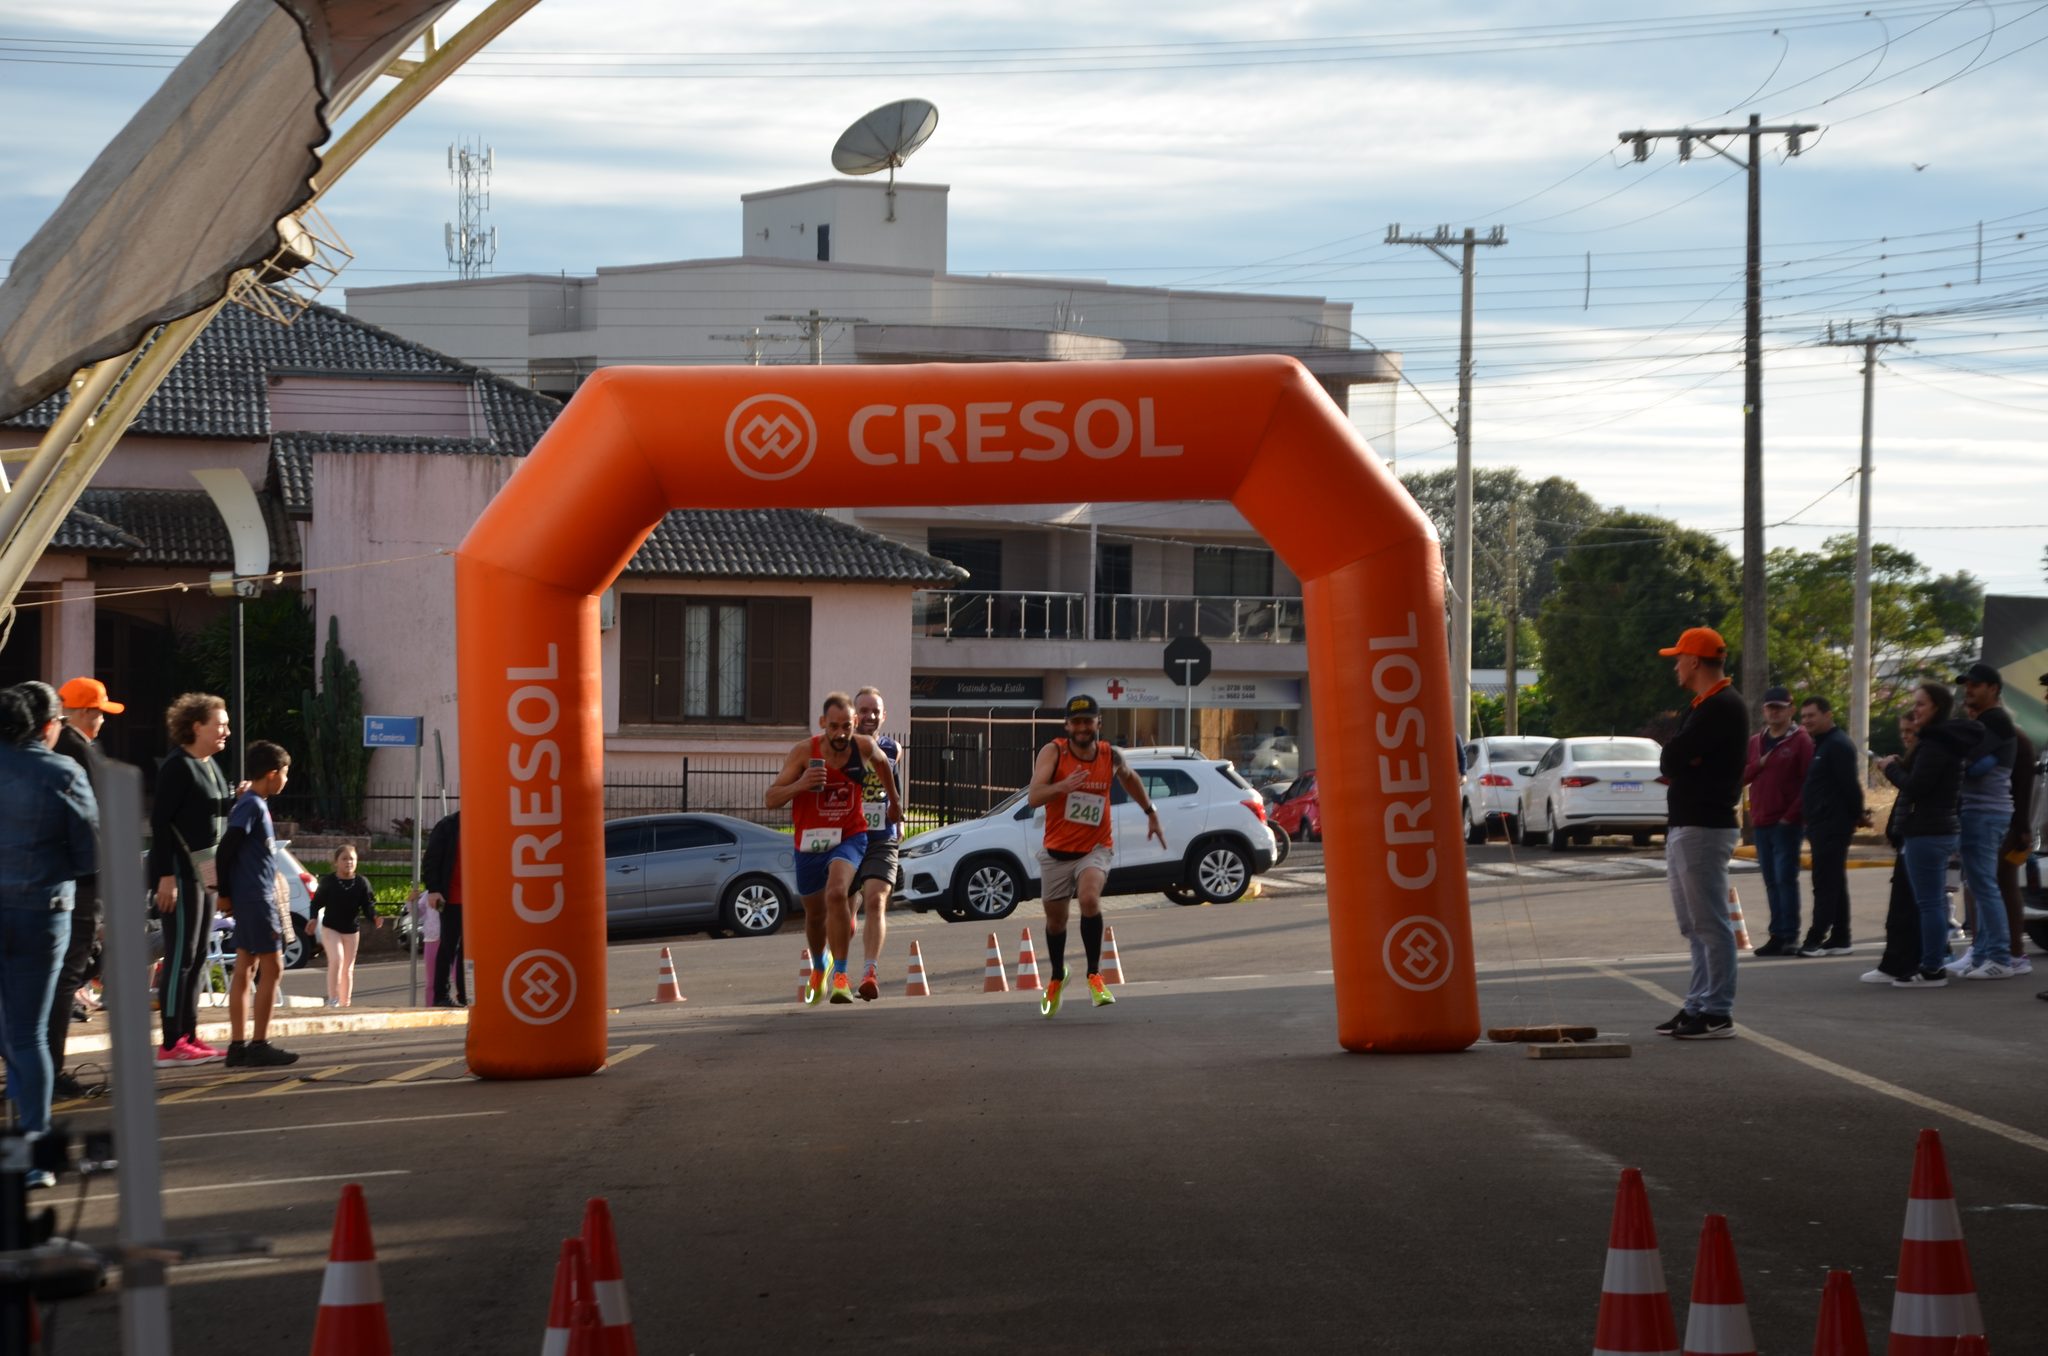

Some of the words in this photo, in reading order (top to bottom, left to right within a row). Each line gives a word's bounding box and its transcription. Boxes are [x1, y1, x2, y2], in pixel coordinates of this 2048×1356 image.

[848, 397, 1184, 466] CRESOL
[957, 683, 988, 693] Vestindo
[989, 683, 1002, 693] Seu
[1004, 683, 1025, 693] Estilo
[506, 643, 565, 924] CRESOL
[1368, 611, 1437, 890] CRESOL
[1069, 802, 1100, 823] 248
